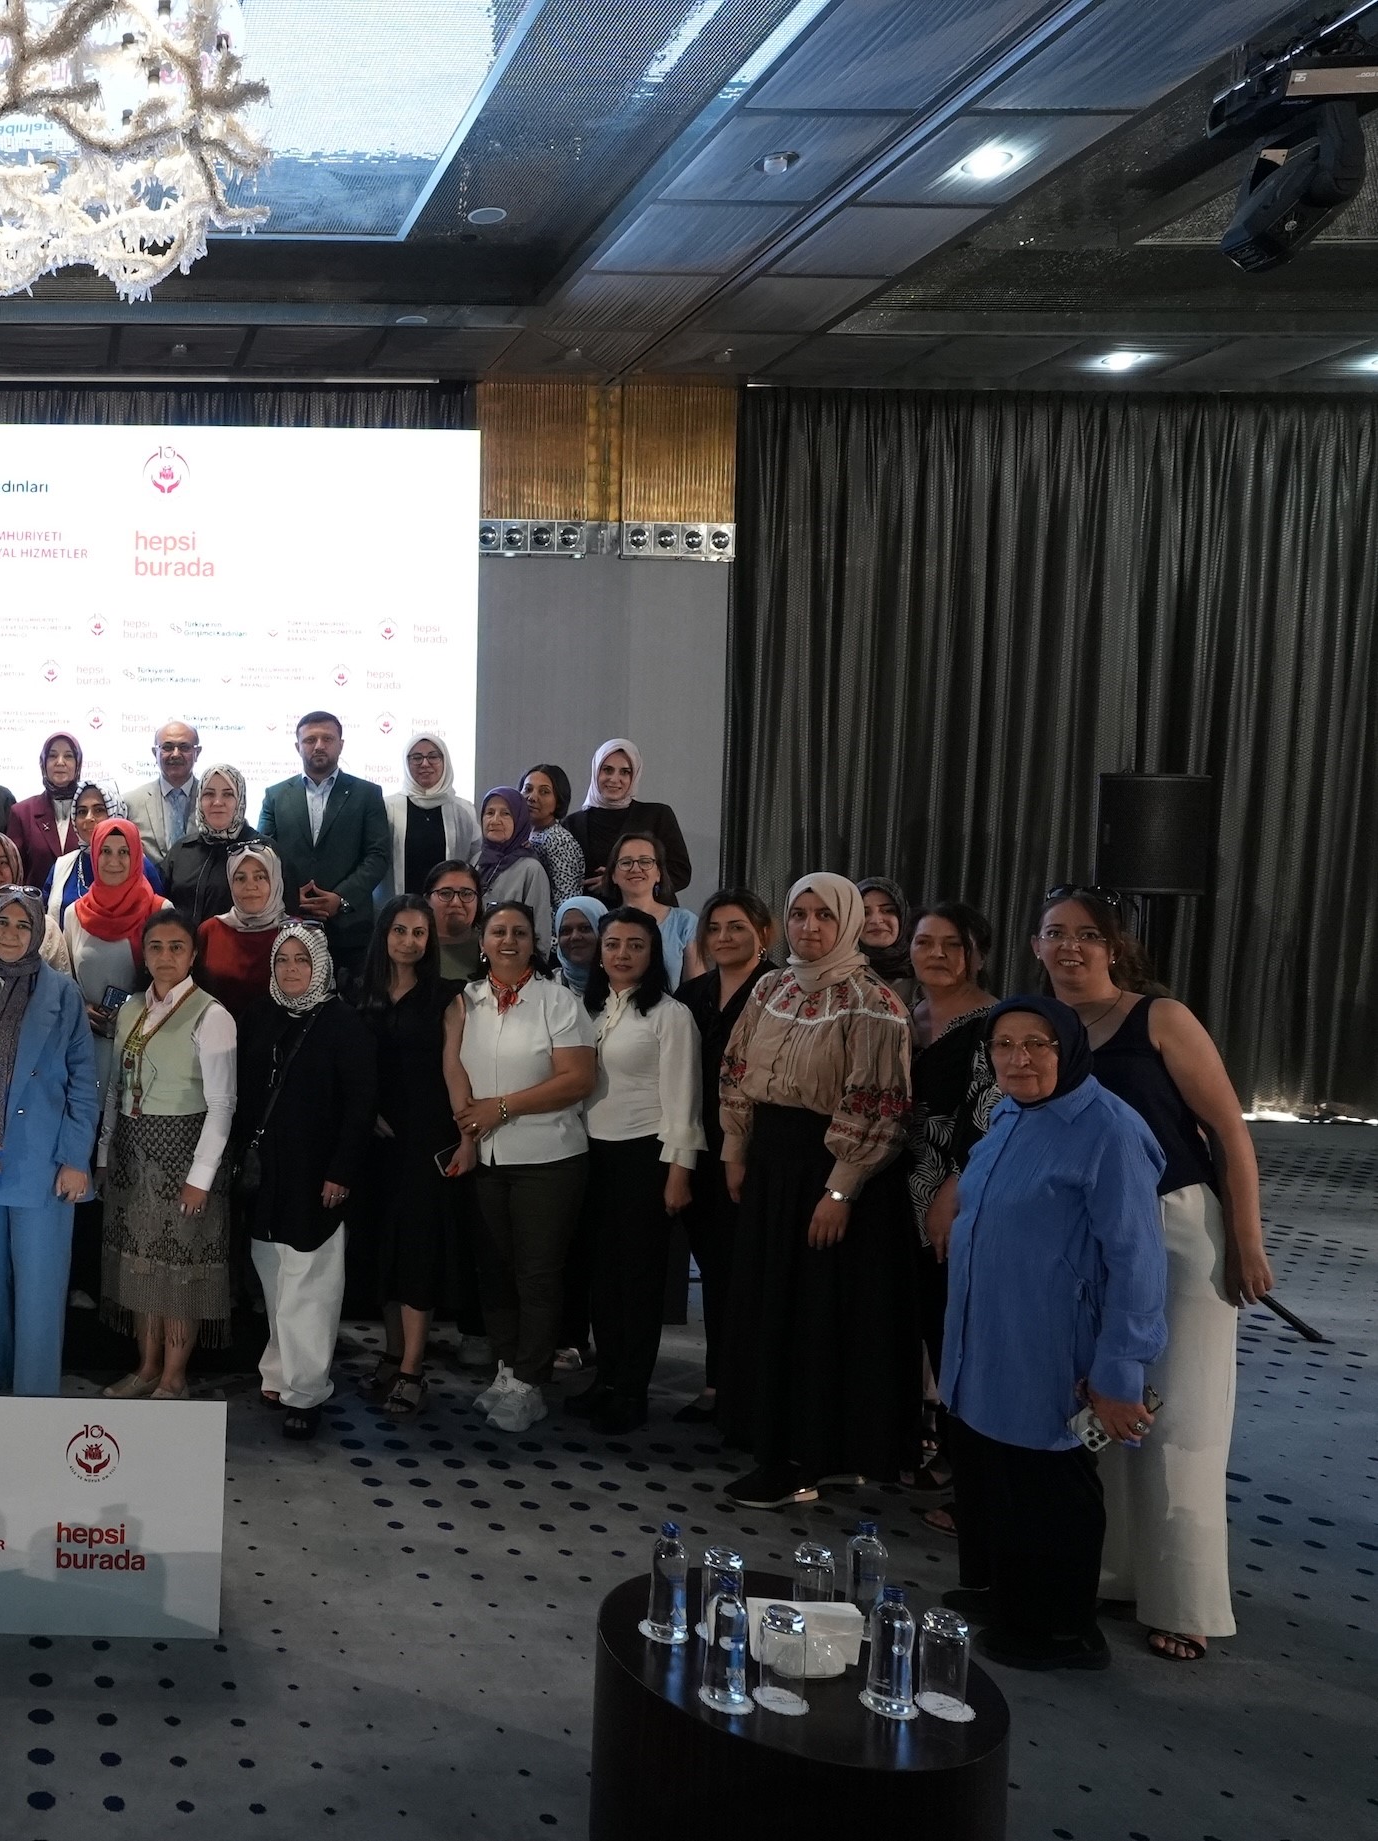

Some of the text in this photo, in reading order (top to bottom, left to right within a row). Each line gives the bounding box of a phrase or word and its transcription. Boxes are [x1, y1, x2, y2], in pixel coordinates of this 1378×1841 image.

[20, 546, 88, 559] HİZMETLER
[135, 530, 196, 556] hepsi
[135, 556, 215, 577] burada
[83, 1424, 104, 1439] 10
[57, 1522, 125, 1549] hepsi
[56, 1547, 146, 1570] burada
